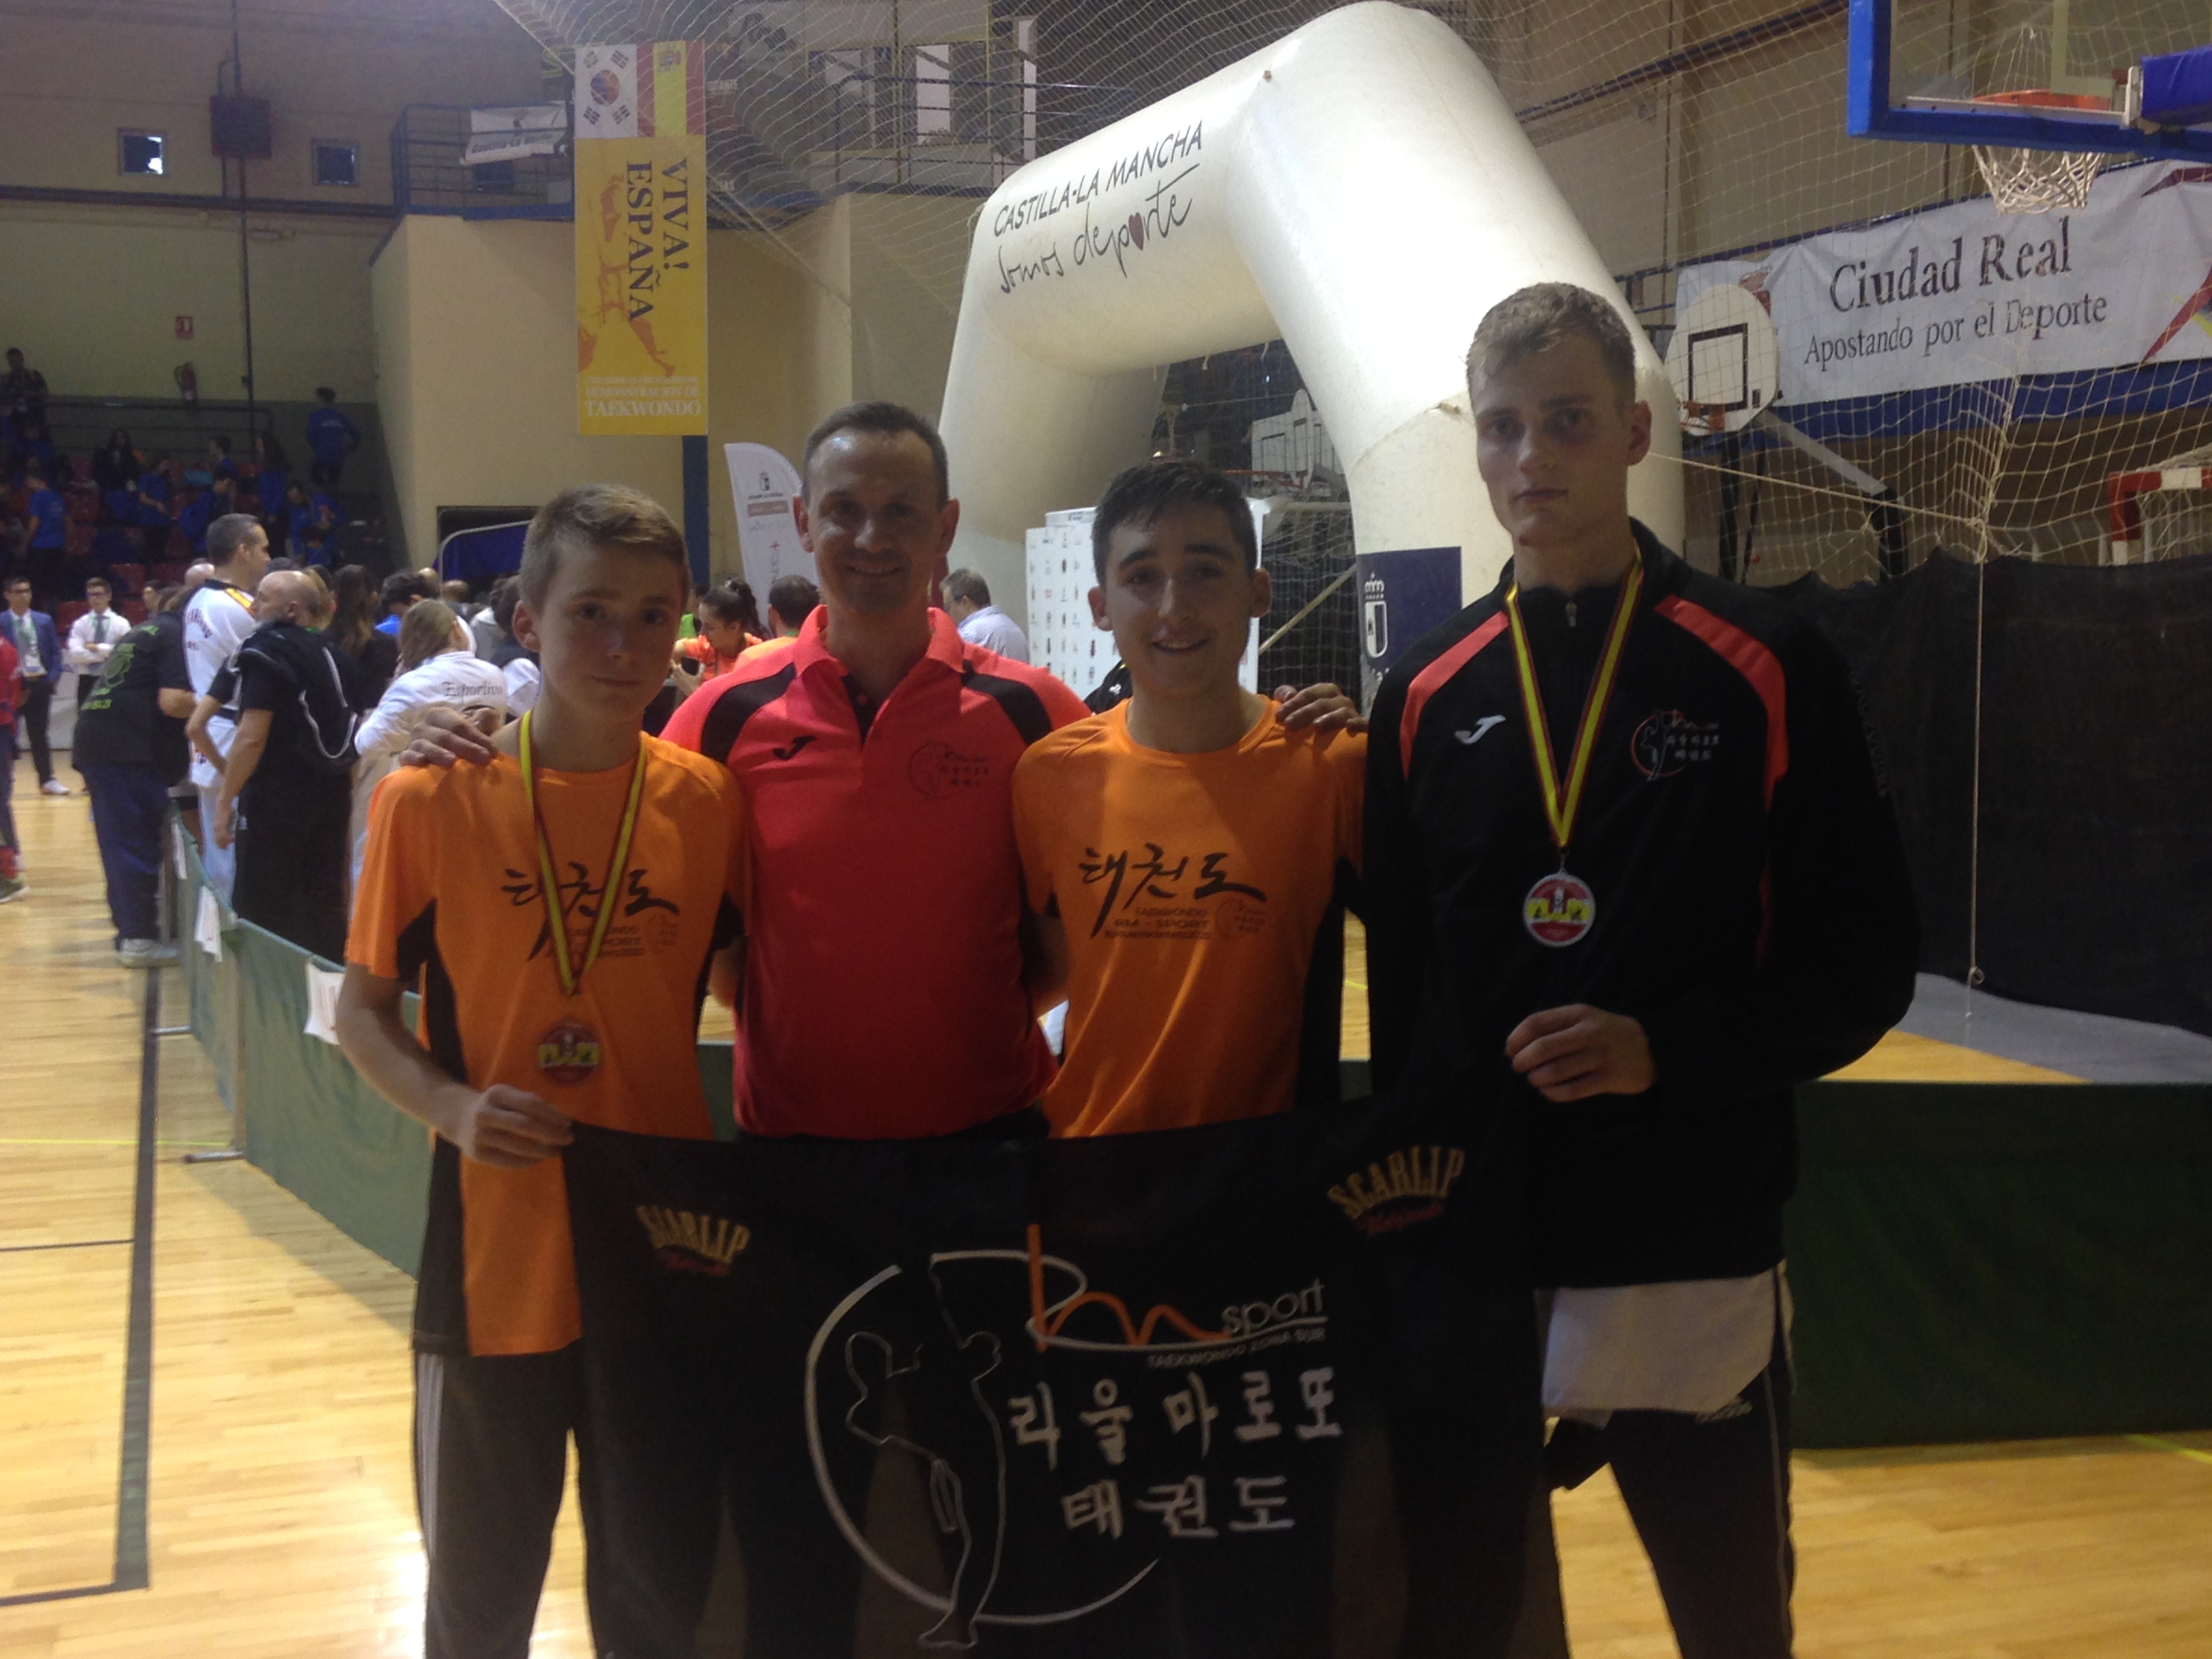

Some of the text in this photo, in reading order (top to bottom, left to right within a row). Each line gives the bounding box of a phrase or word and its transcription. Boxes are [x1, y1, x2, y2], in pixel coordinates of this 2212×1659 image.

[1105, 119, 1204, 192] MANCHA
[627, 161, 662, 321] ESPAÑA
[1830, 215, 2072, 312] Ciudad Real
[1804, 293, 2108, 372] Apostando por el Deporte
[586, 400, 701, 417] TAEKWONDO
[1222, 1278, 1324, 1337] sport
